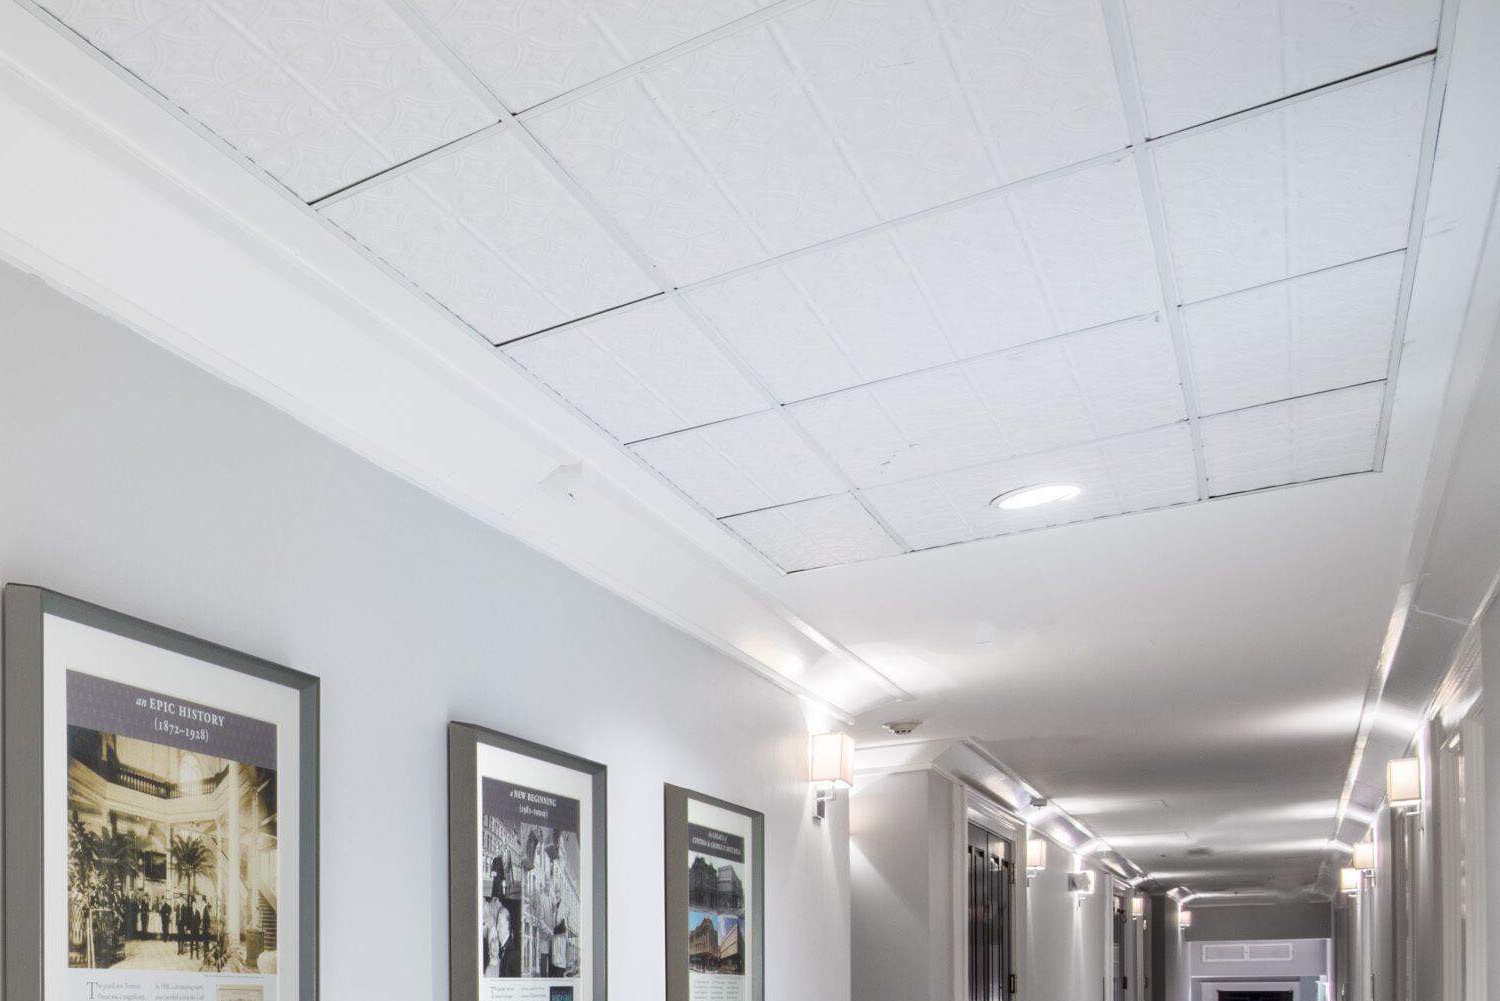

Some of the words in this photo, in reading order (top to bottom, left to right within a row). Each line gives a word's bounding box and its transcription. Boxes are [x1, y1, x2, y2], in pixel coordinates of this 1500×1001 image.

[135, 696, 147, 708] an
[149, 697, 176, 715] EPIC
[179, 705, 225, 727] HISTORY
[514, 789, 527, 799] NEW
